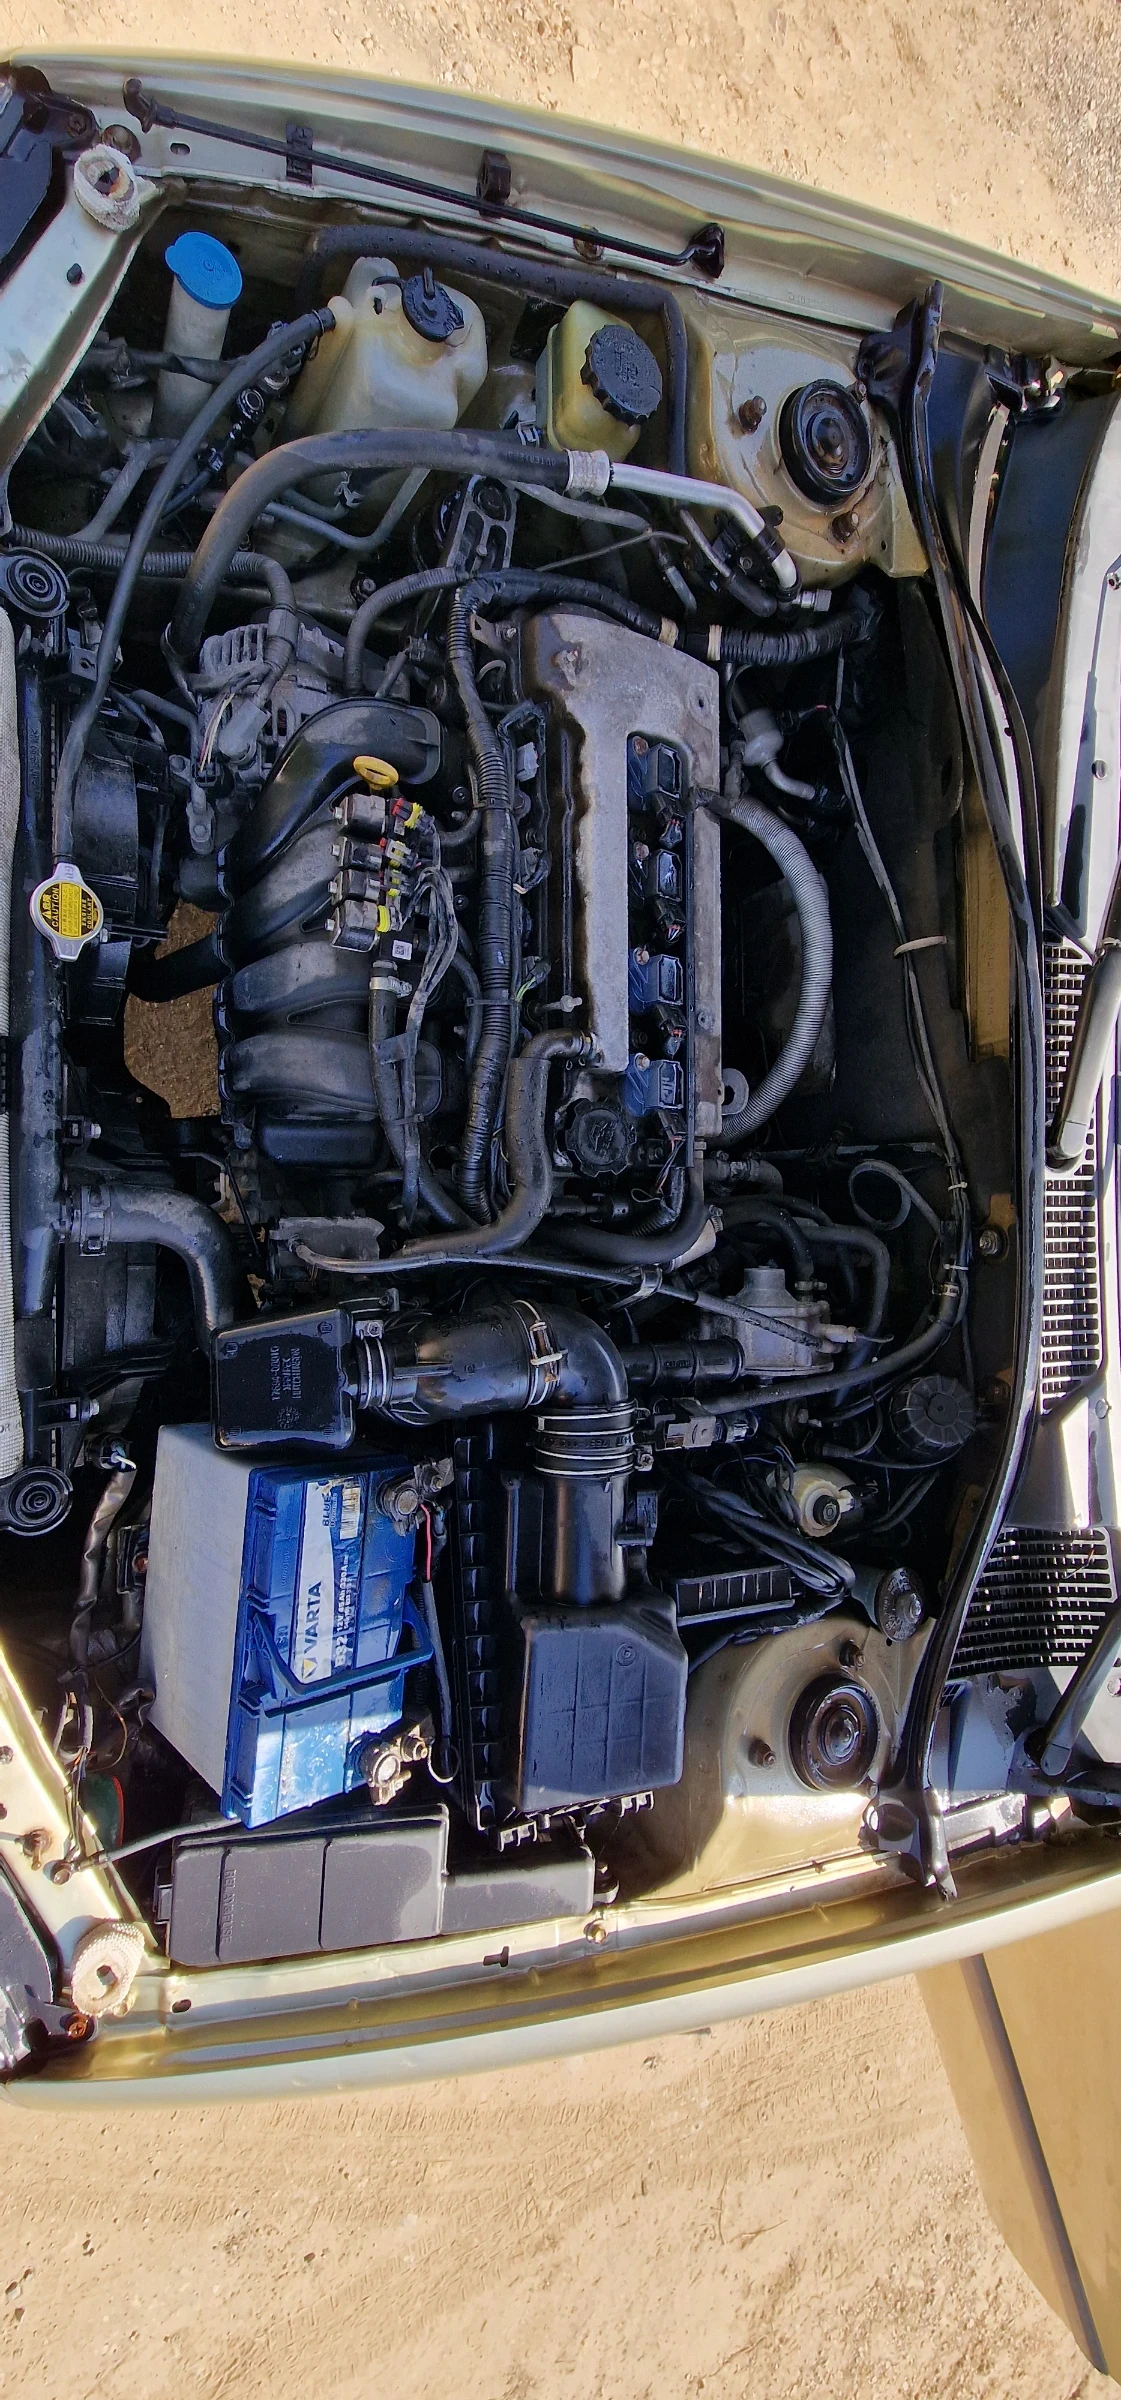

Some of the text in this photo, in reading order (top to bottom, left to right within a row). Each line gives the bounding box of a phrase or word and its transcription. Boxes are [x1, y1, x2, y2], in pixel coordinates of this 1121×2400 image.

[51, 887, 60, 928] CAUTION
[322, 1493, 332, 1527] BLUE
[302, 1580, 323, 1655] VARTA
[336, 1615, 345, 1632] 12V
[334, 1635, 349, 1668] B32
